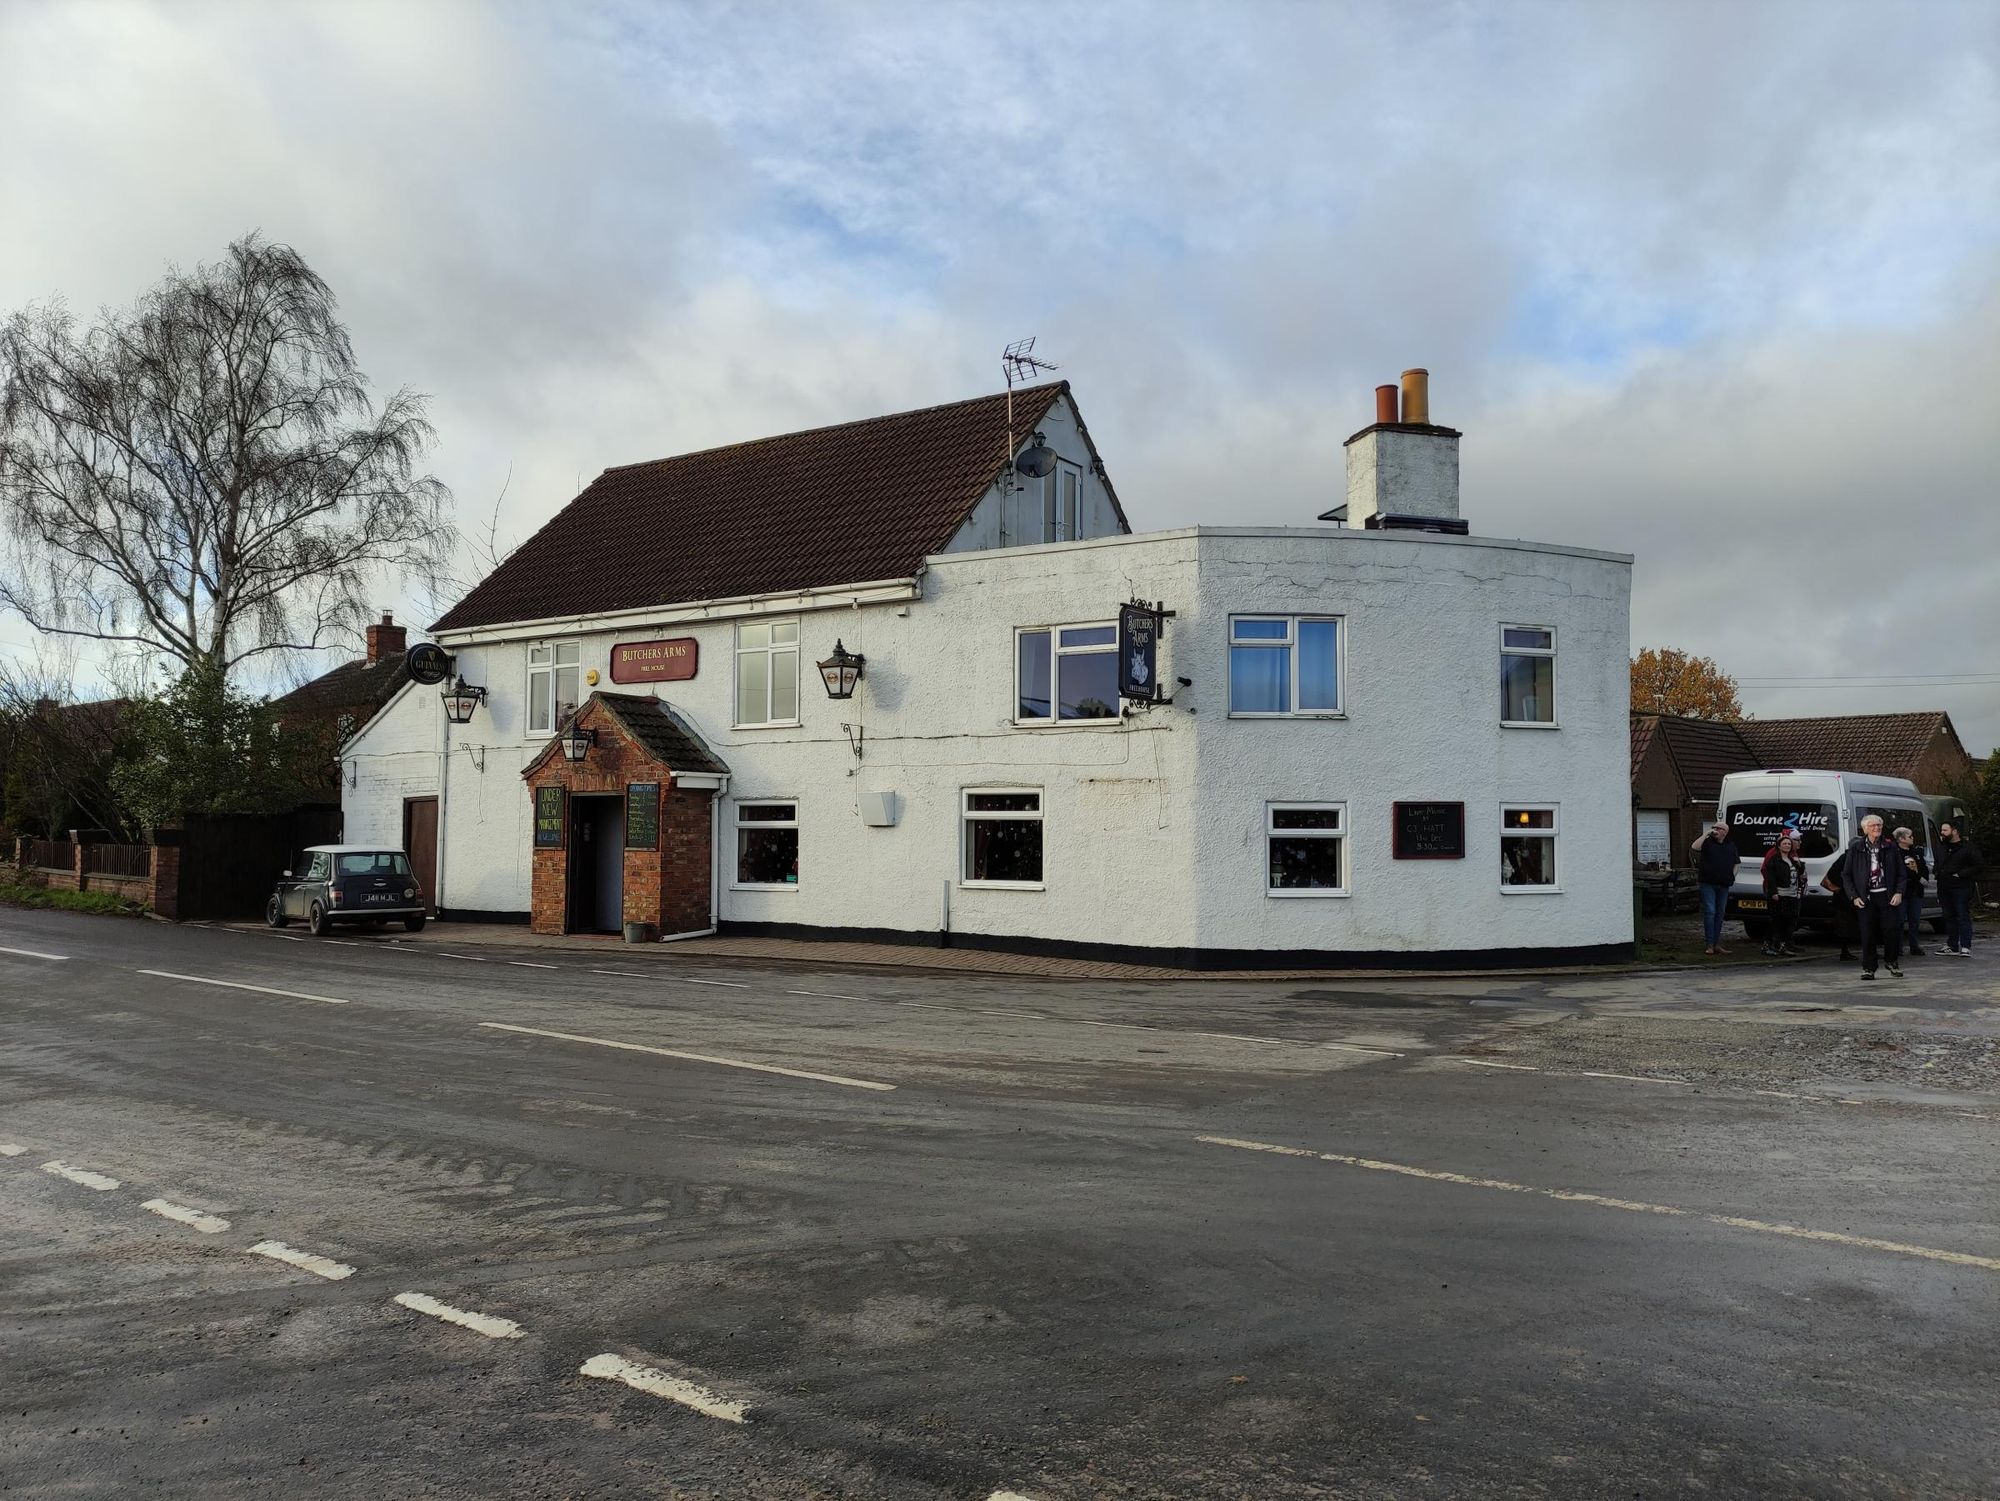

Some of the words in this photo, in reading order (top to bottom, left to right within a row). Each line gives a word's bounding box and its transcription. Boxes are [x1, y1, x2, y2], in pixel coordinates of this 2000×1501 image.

[1127, 615, 1153, 632] BUTCHERS
[1132, 629, 1149, 647] ARMS
[622, 648, 661, 661] BUTCHERS
[663, 645, 686, 658] ARMS
[542, 788, 561, 801] UNDER
[542, 801, 559, 816] NEW
